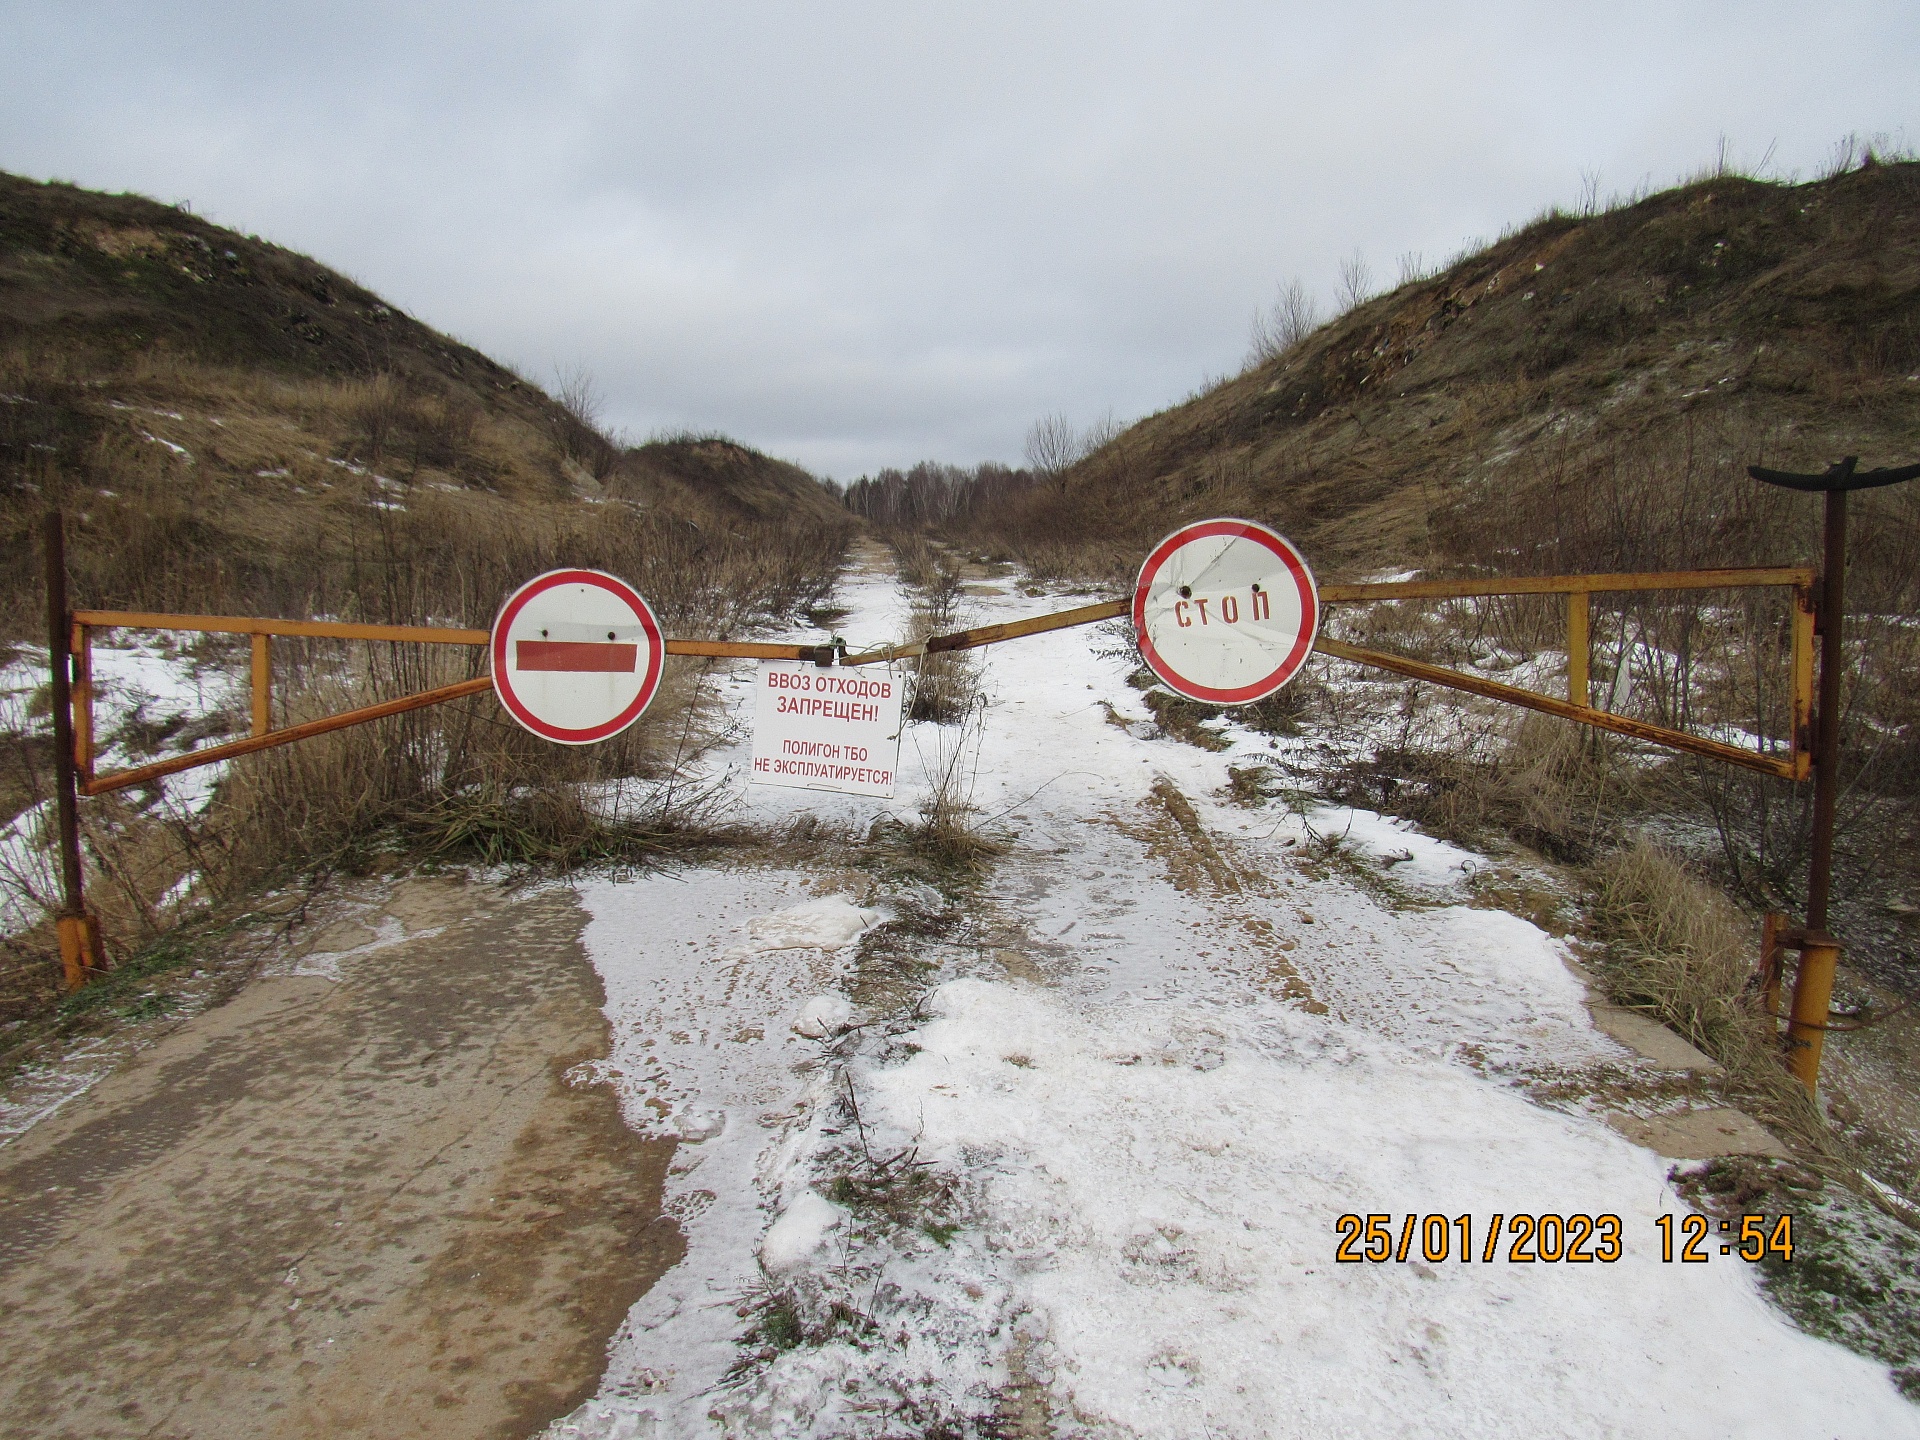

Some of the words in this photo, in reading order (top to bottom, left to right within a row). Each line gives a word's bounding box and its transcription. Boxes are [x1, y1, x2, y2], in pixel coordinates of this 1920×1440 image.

[1174, 591, 1270, 628] СТОП
[768, 672, 811, 691] ВВОЗ
[815, 676, 892, 699] ОТХОДОВ
[776, 695, 879, 722] ЗАПРЕЩЕН!
[782, 739, 840, 759] ПОЛИГОН
[843, 745, 868, 761] ТБО
[754, 757, 770, 772] НЕ
[773, 759, 893, 785] ЭКСПЛУАТИРУЕТСЯ!
